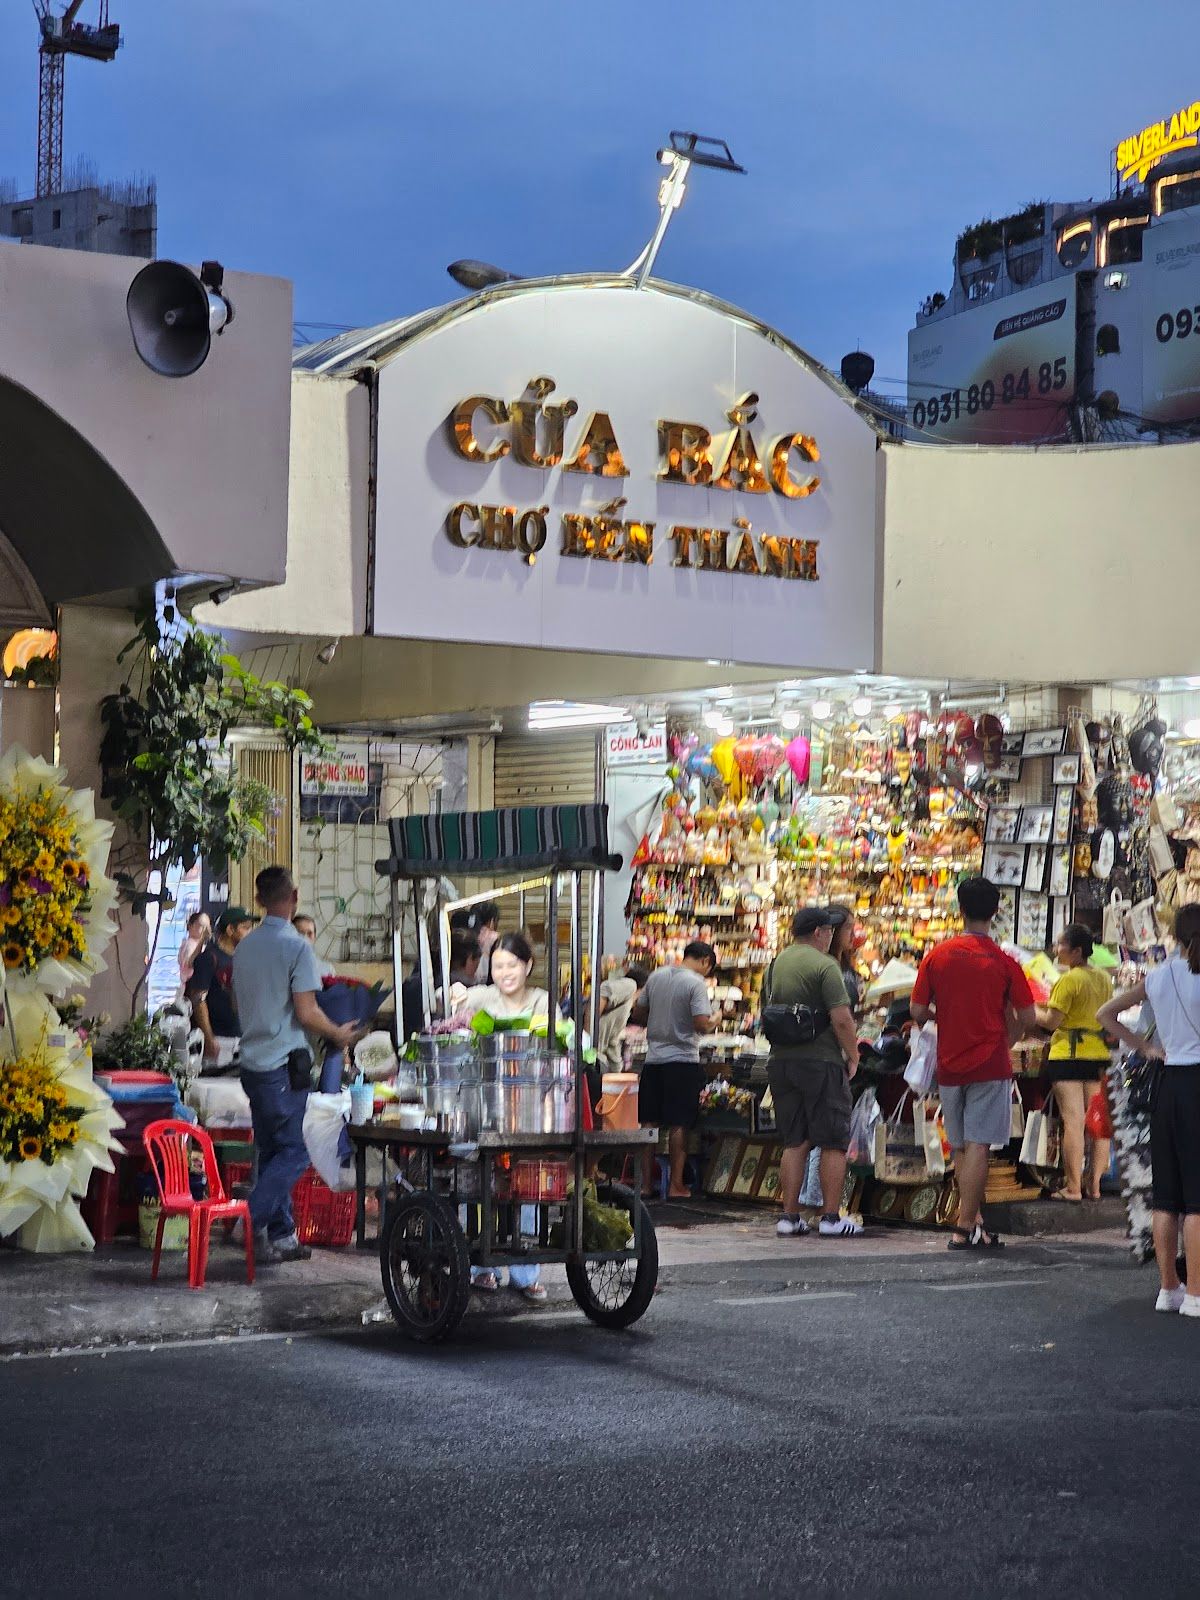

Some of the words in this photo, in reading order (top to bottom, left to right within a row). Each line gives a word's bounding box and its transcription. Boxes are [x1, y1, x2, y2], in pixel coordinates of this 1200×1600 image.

[1117, 101, 1200, 171] SILVERLAND
[913, 389, 961, 429] 0931
[968, 379, 995, 415] 80
[1002, 366, 1030, 404] 84
[1039, 356, 1067, 394] 85
[447, 376, 630, 478] CỬA
[656, 391, 821, 499] BẮC
[447, 501, 550, 566] CHỢ
[560, 496, 656, 566] BẾN
[666, 517, 820, 581] THÀNH
